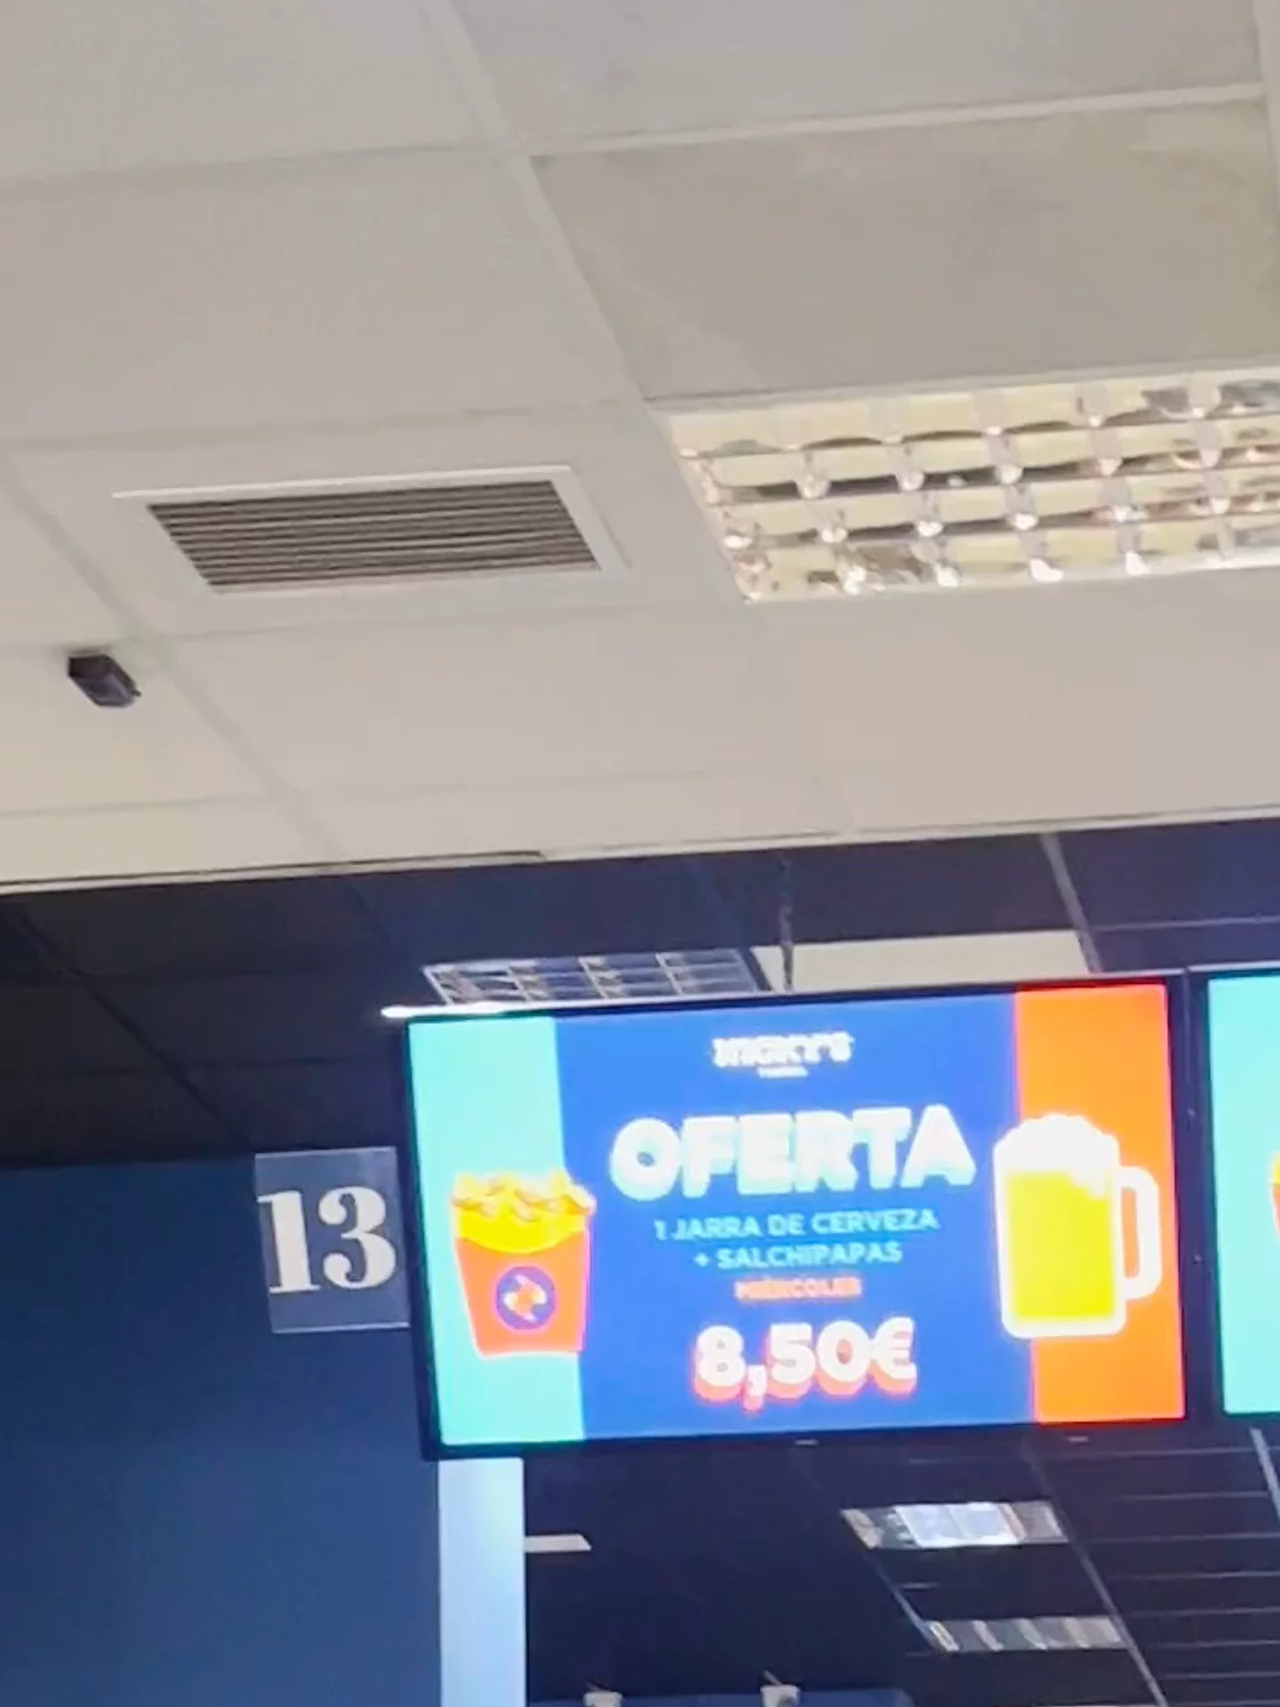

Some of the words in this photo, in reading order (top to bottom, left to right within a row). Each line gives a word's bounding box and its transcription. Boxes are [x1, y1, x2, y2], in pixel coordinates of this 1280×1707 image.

[610, 1104, 977, 1201] OFERTA
[256, 1186, 397, 1294] 13
[654, 1219, 668, 1241] 1
[672, 1215, 762, 1241] JARRA
[767, 1213, 807, 1237] DE
[811, 1208, 940, 1235] CERVEZA
[716, 1241, 904, 1270] SALCHIPAPAS
[694, 1317, 918, 1409] 8,50€
